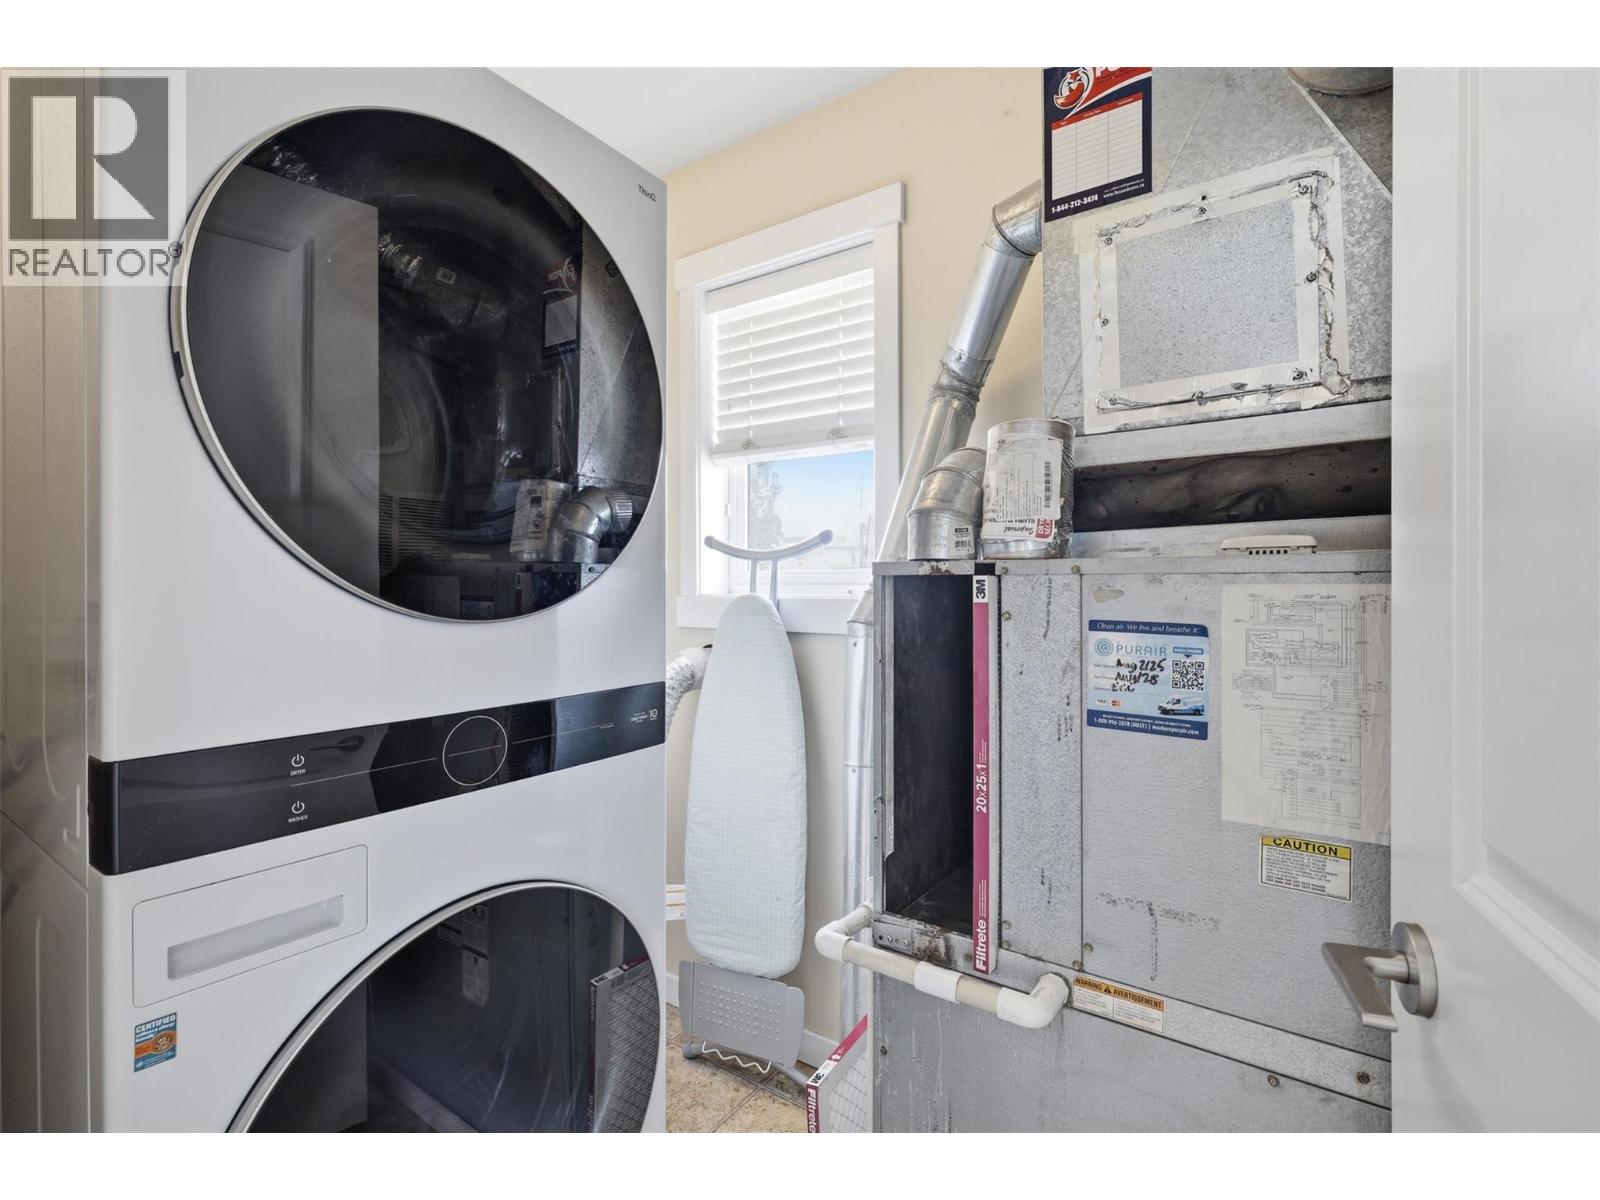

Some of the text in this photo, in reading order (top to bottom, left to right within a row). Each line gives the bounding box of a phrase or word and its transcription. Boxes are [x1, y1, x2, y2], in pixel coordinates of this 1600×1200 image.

[638, 184, 656, 202] ThinQ
[976, 579, 986, 599] 3M
[1165, 625, 1192, 633] breathe
[1116, 643, 1167, 657] PURAIR
[288, 814, 308, 823] WASHER
[1273, 838, 1338, 856] CAUTION
[975, 919, 986, 971] Filtrete
[1075, 978, 1102, 991] WARNING
[1113, 988, 1162, 1009] AVERTISSEMENT
[136, 1015, 175, 1033] CERTIFIED
[810, 1073, 824, 1084] 3M
